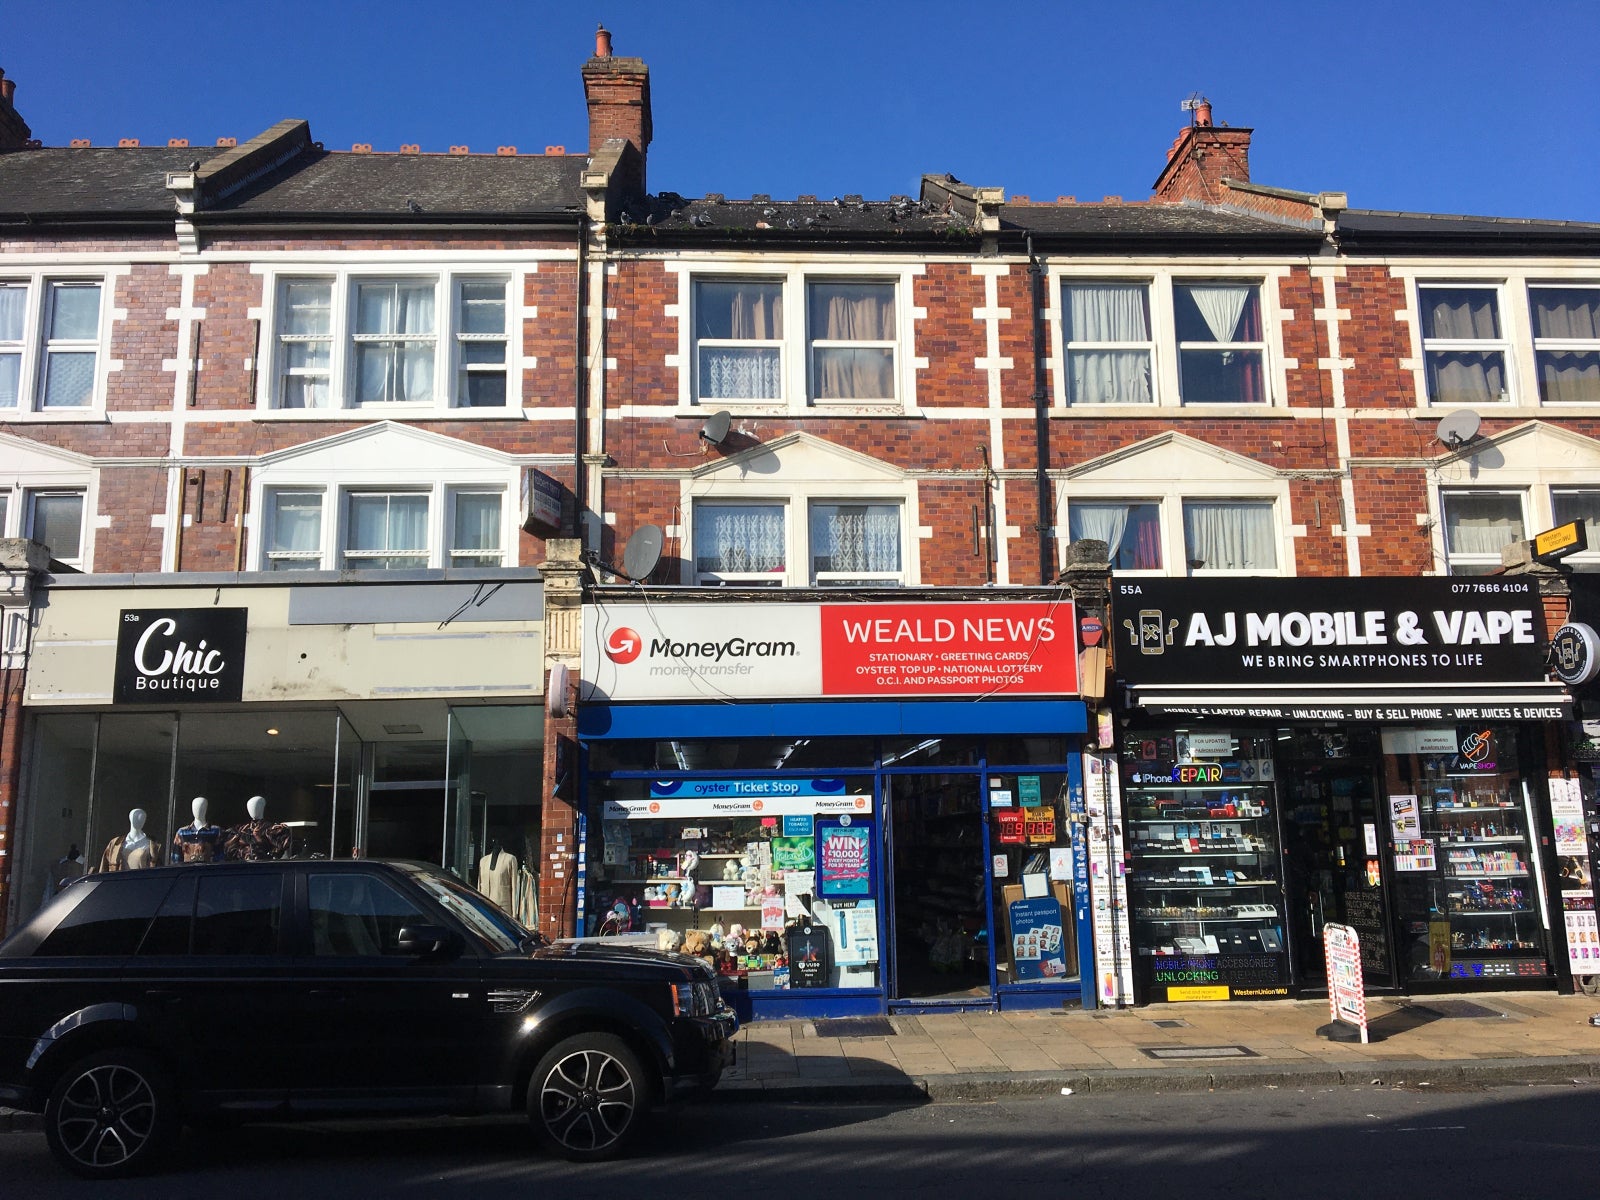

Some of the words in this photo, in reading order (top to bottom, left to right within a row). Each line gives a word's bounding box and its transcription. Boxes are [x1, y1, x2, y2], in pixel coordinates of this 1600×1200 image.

[1120, 586, 1142, 595] 55A
[1452, 584, 1470, 593] 077
[1473, 584, 1500, 593] 7666
[1502, 584, 1528, 593] 4104
[843, 618, 955, 643] WEALD
[963, 617, 1055, 642] NEWS
[1185, 611, 1237, 647] AJ
[1246, 611, 1388, 647] MOBILE
[1396, 610, 1429, 646] &
[1433, 610, 1535, 646] VAPE
[134, 618, 225, 676] Chic
[650, 638, 796, 662] MoneyGram
[869, 653, 933, 662] STATIONARY
[941, 652, 993, 661] GREETING
[995, 652, 1029, 661] CARDS
[1242, 655, 1263, 667] WE
[1268, 655, 1315, 667] BRING
[1319, 654, 1428, 667] SMARTPHONES
[1432, 654, 1450, 666] TO
[1455, 654, 1483, 666] LIFE
[650, 664, 695, 679] money
[699, 662, 754, 676] transfer
[856, 666, 897, 675] OYSTER
[900, 665, 921, 674] TOP
[923, 665, 936, 674] UP
[943, 665, 995, 673] NATIONAL
[997, 664, 1043, 673] LOTTERY
[136, 676, 220, 692] Boutique
[876, 676, 901, 685] O.C.I.
[904, 676, 926, 685] AND
[927, 676, 979, 684] PASSPORT
[982, 675, 1024, 684] PHOTOS
[1211, 708, 1247, 716] LAPTOP
[1248, 709, 1282, 718] REPAIR
[1292, 709, 1345, 719] UNLOCKING
[1354, 709, 1373, 719] BUY
[1375, 708, 1384, 719] &
[1387, 709, 1410, 719] SELL
[1411, 709, 1443, 719] PHONE
[1454, 708, 1480, 718] VAPE
[1481, 708, 1512, 718] JUICES
[1513, 708, 1523, 718] &
[1523, 707, 1563, 718] DEVICES
[1142, 773, 1173, 783] iPhone
[1172, 767, 1220, 782] REPAIR
[695, 783, 729, 794] oyster
[733, 781, 769, 793] Ticket
[772, 781, 799, 794] Stop
[609, 805, 647, 813] MoneyGram
[713, 803, 751, 811] MoneyGram
[828, 837, 860, 850] WIN
[828, 850, 860, 859] £10,000
[1155, 959, 1185, 970] MOBILE
[1188, 959, 1217, 970] PHONE
[1217, 958, 1275, 969] ACCESSORIES
[1156, 970, 1219, 981] UNLOCKING
